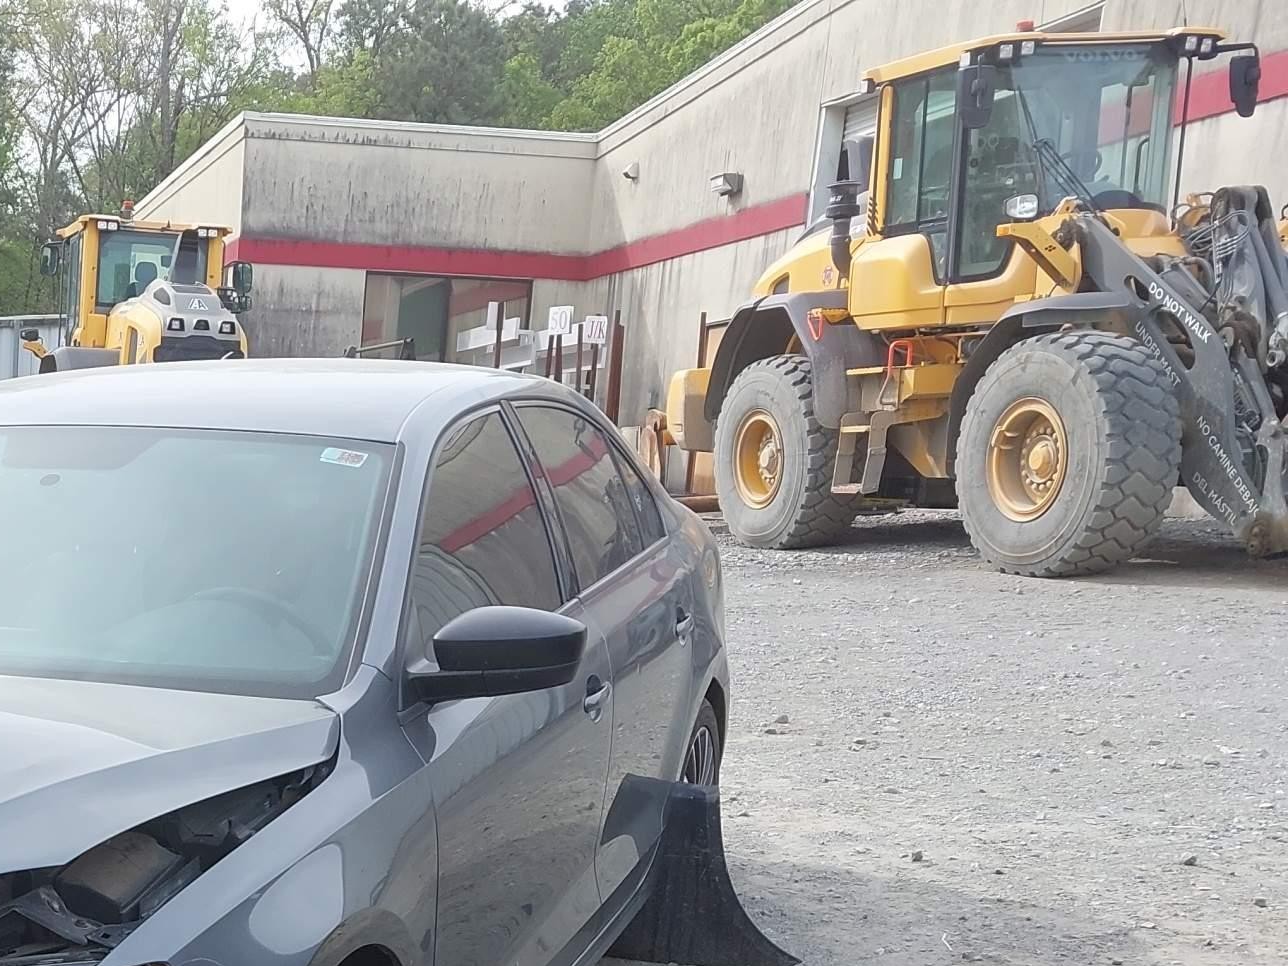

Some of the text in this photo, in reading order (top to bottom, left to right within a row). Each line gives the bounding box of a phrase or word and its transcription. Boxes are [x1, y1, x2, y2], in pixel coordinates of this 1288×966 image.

[550, 310, 568, 329] 50
[587, 320, 606, 339] J/K
[1149, 282, 1212, 344] DO NOT WALK
[1135, 321, 1182, 387] UNDER MAST
[1196, 415, 1211, 436] NO
[1208, 435, 1237, 479] CAMINE
[1193, 471, 1237, 526] DEL MÁSTIL
